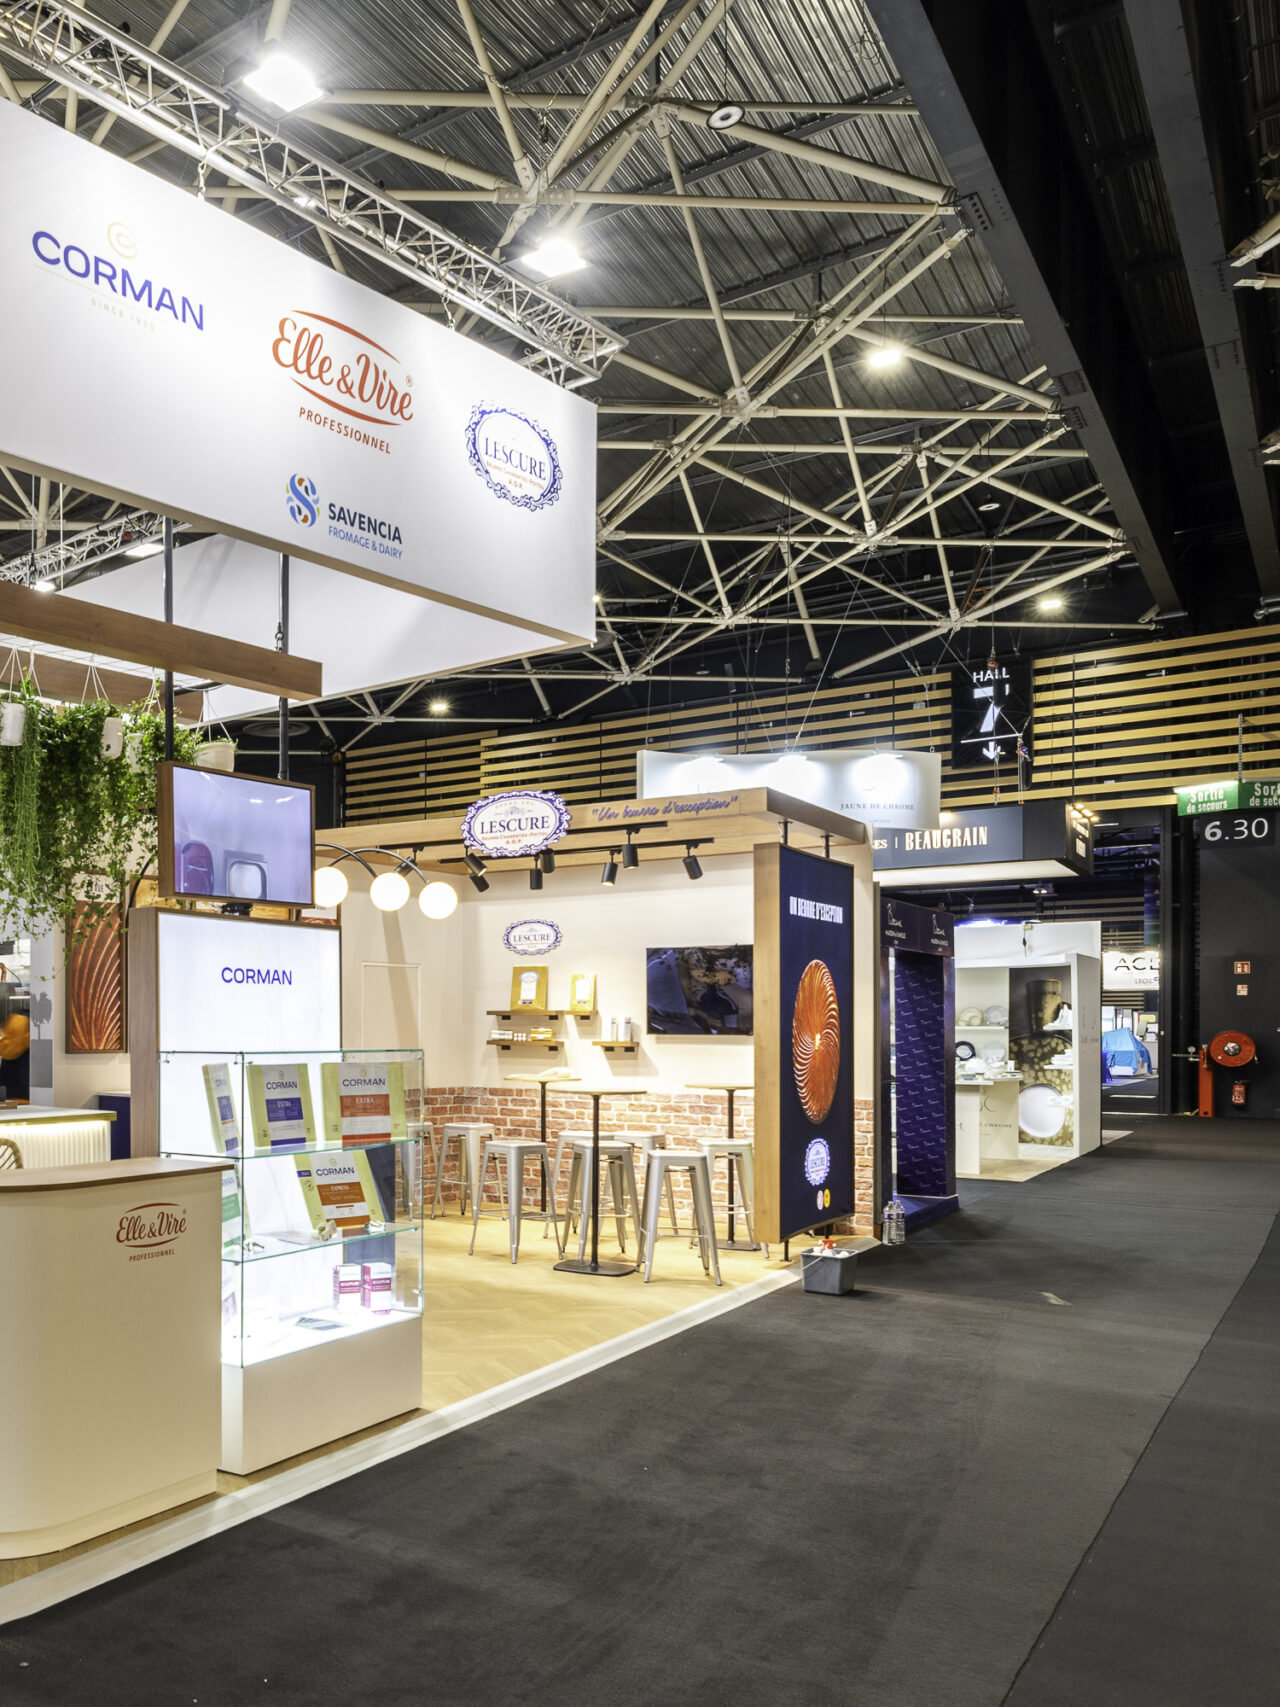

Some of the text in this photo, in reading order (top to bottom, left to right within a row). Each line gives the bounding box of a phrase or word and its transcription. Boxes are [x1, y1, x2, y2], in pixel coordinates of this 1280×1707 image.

[32, 230, 203, 331] CORMAN
[299, 407, 392, 454] PROFESSIONNEL
[485, 437, 546, 481] LESCURE
[328, 502, 403, 544] SAVENCIA
[328, 525, 370, 550] FROMAGE
[378, 542, 403, 560] DAIRY
[1190, 787, 1224, 803] Sortie
[1250, 796, 1261, 807] de
[884, 803, 915, 811] CHROME
[1186, 799, 1228, 813] de secours
[481, 815, 550, 834] LESCURE
[1205, 818, 1269, 841] 6.30
[905, 826, 988, 851] BEAUGRAIN
[513, 933, 551, 943] LESCURE
[221, 967, 292, 985] CORMAN
[265, 1081, 298, 1090] CORMAN
[342, 1078, 386, 1087] CORMAN
[355, 1096, 375, 1104] EXTRA
[315, 1166, 355, 1176] CORMAN
[128, 1248, 175, 1262] PROFESSIONNEL
